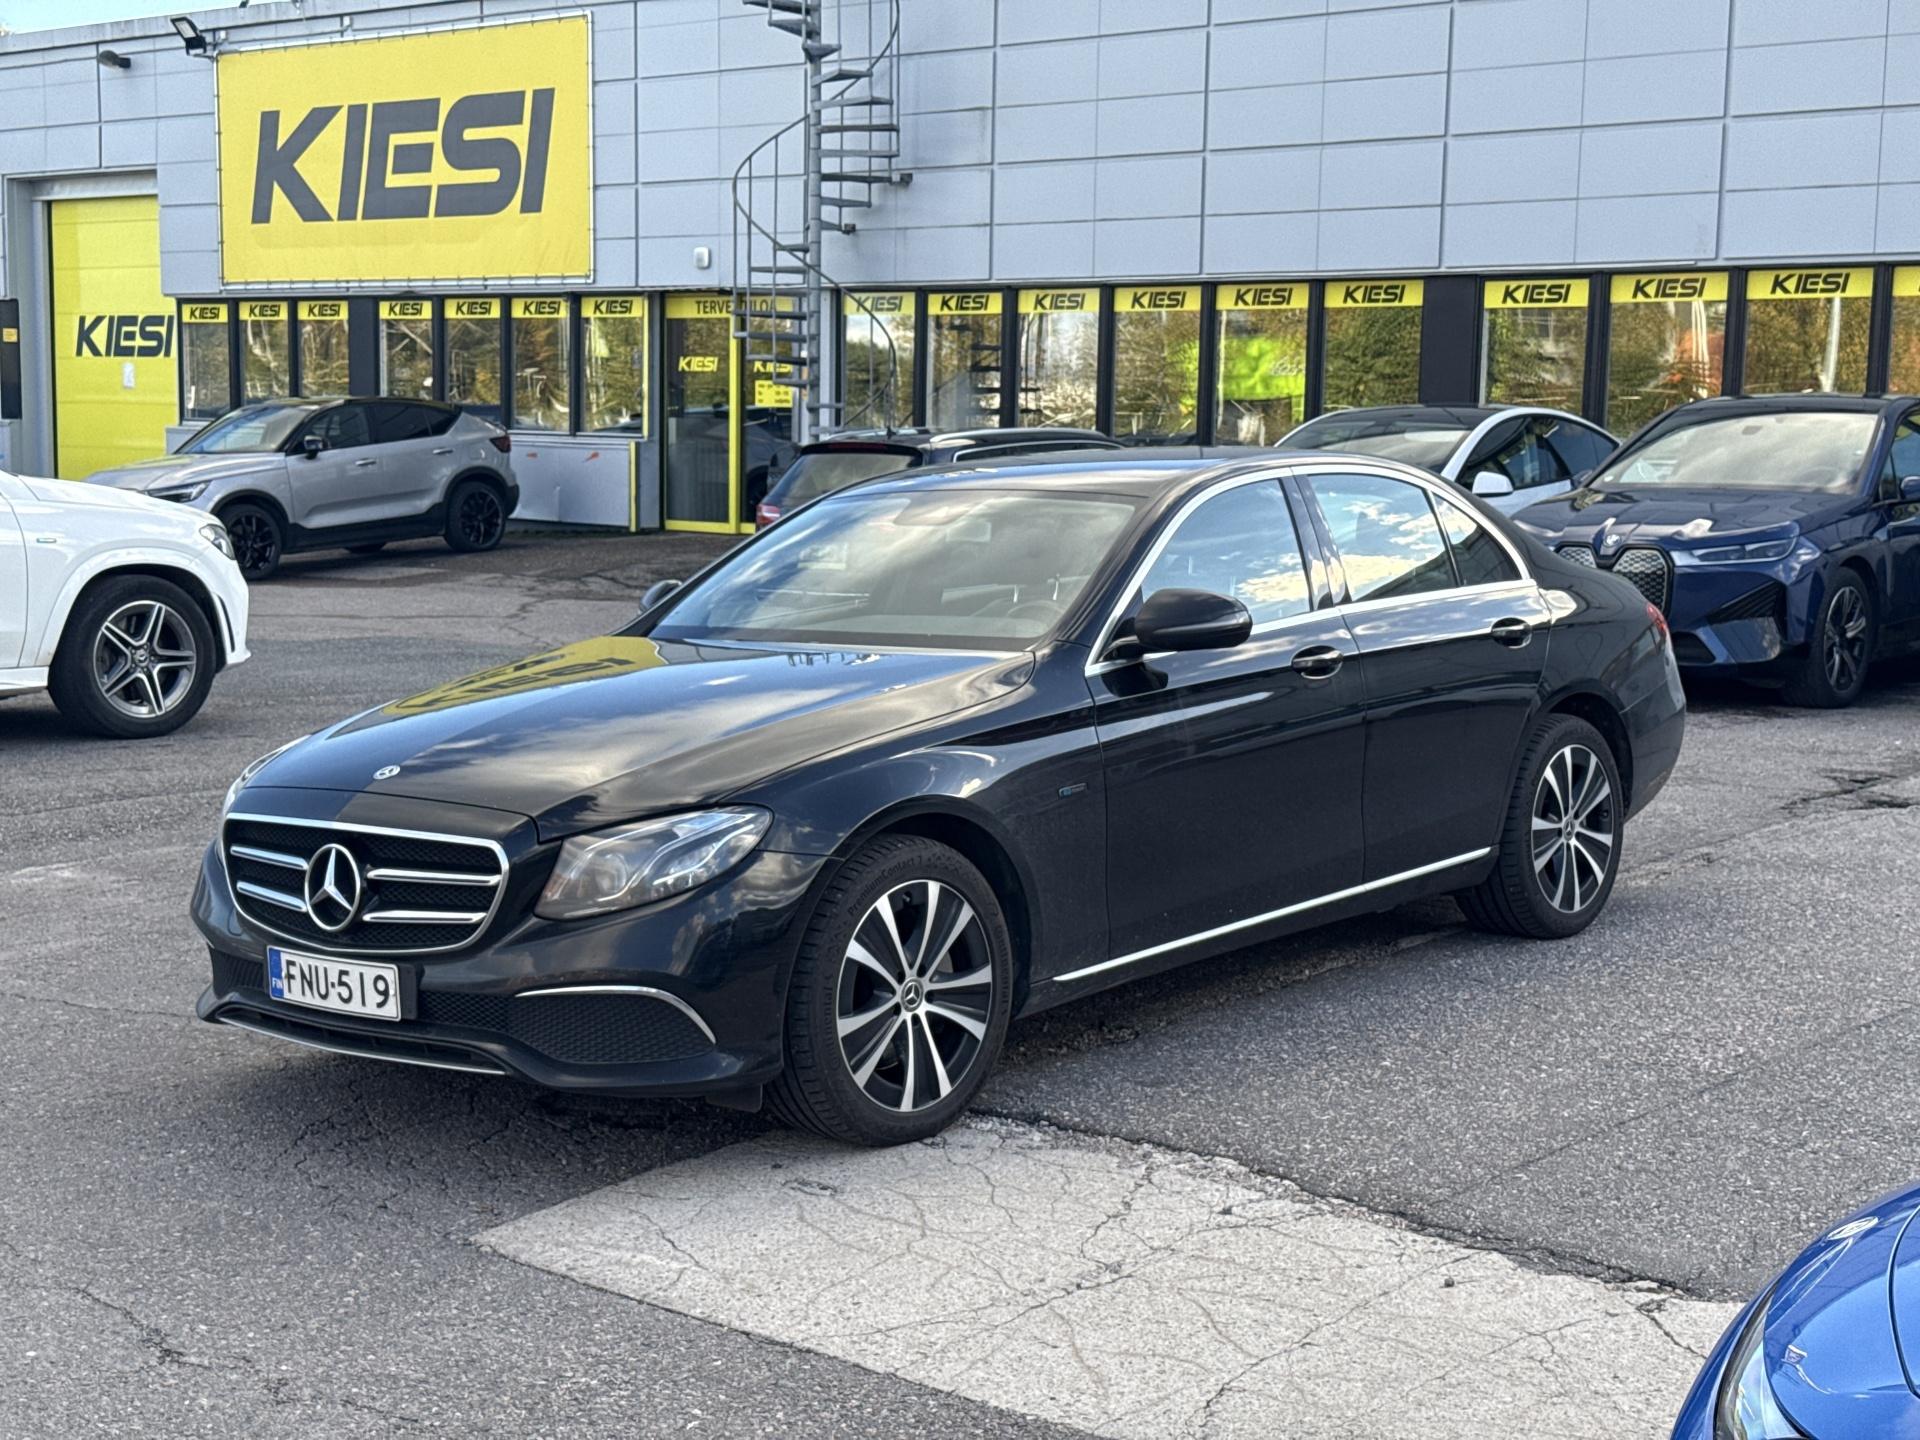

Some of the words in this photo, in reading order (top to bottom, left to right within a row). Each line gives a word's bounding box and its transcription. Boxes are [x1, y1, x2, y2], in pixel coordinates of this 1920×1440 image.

[251, 88, 555, 224] KIESI
[1632, 277, 1707, 299] KIESI
[1770, 272, 1851, 294] KIESI
[1034, 293, 1085, 310] KIESI
[1131, 291, 1186, 309] KIESI
[1234, 287, 1293, 306] KIESI
[1343, 284, 1406, 304] KIESI
[1502, 283, 1571, 304] KIESI
[249, 303, 281, 317] KIESI
[308, 303, 341, 316] KIESI
[388, 302, 423, 316] KIESI
[456, 301, 492, 315] KIESI
[523, 300, 561, 315] KIESI
[593, 299, 634, 314] KIESI
[856, 296, 903, 312] KIESI
[940, 294, 989, 311] KIESI
[190, 306, 220, 319] KIESI
[76, 315, 175, 357] KIESI
[678, 356, 718, 372] KIESI
[847, 857, 916, 917] PremiumContact
[273, 978, 283, 988] FIN
[285, 959, 390, 1009] FNU-519
